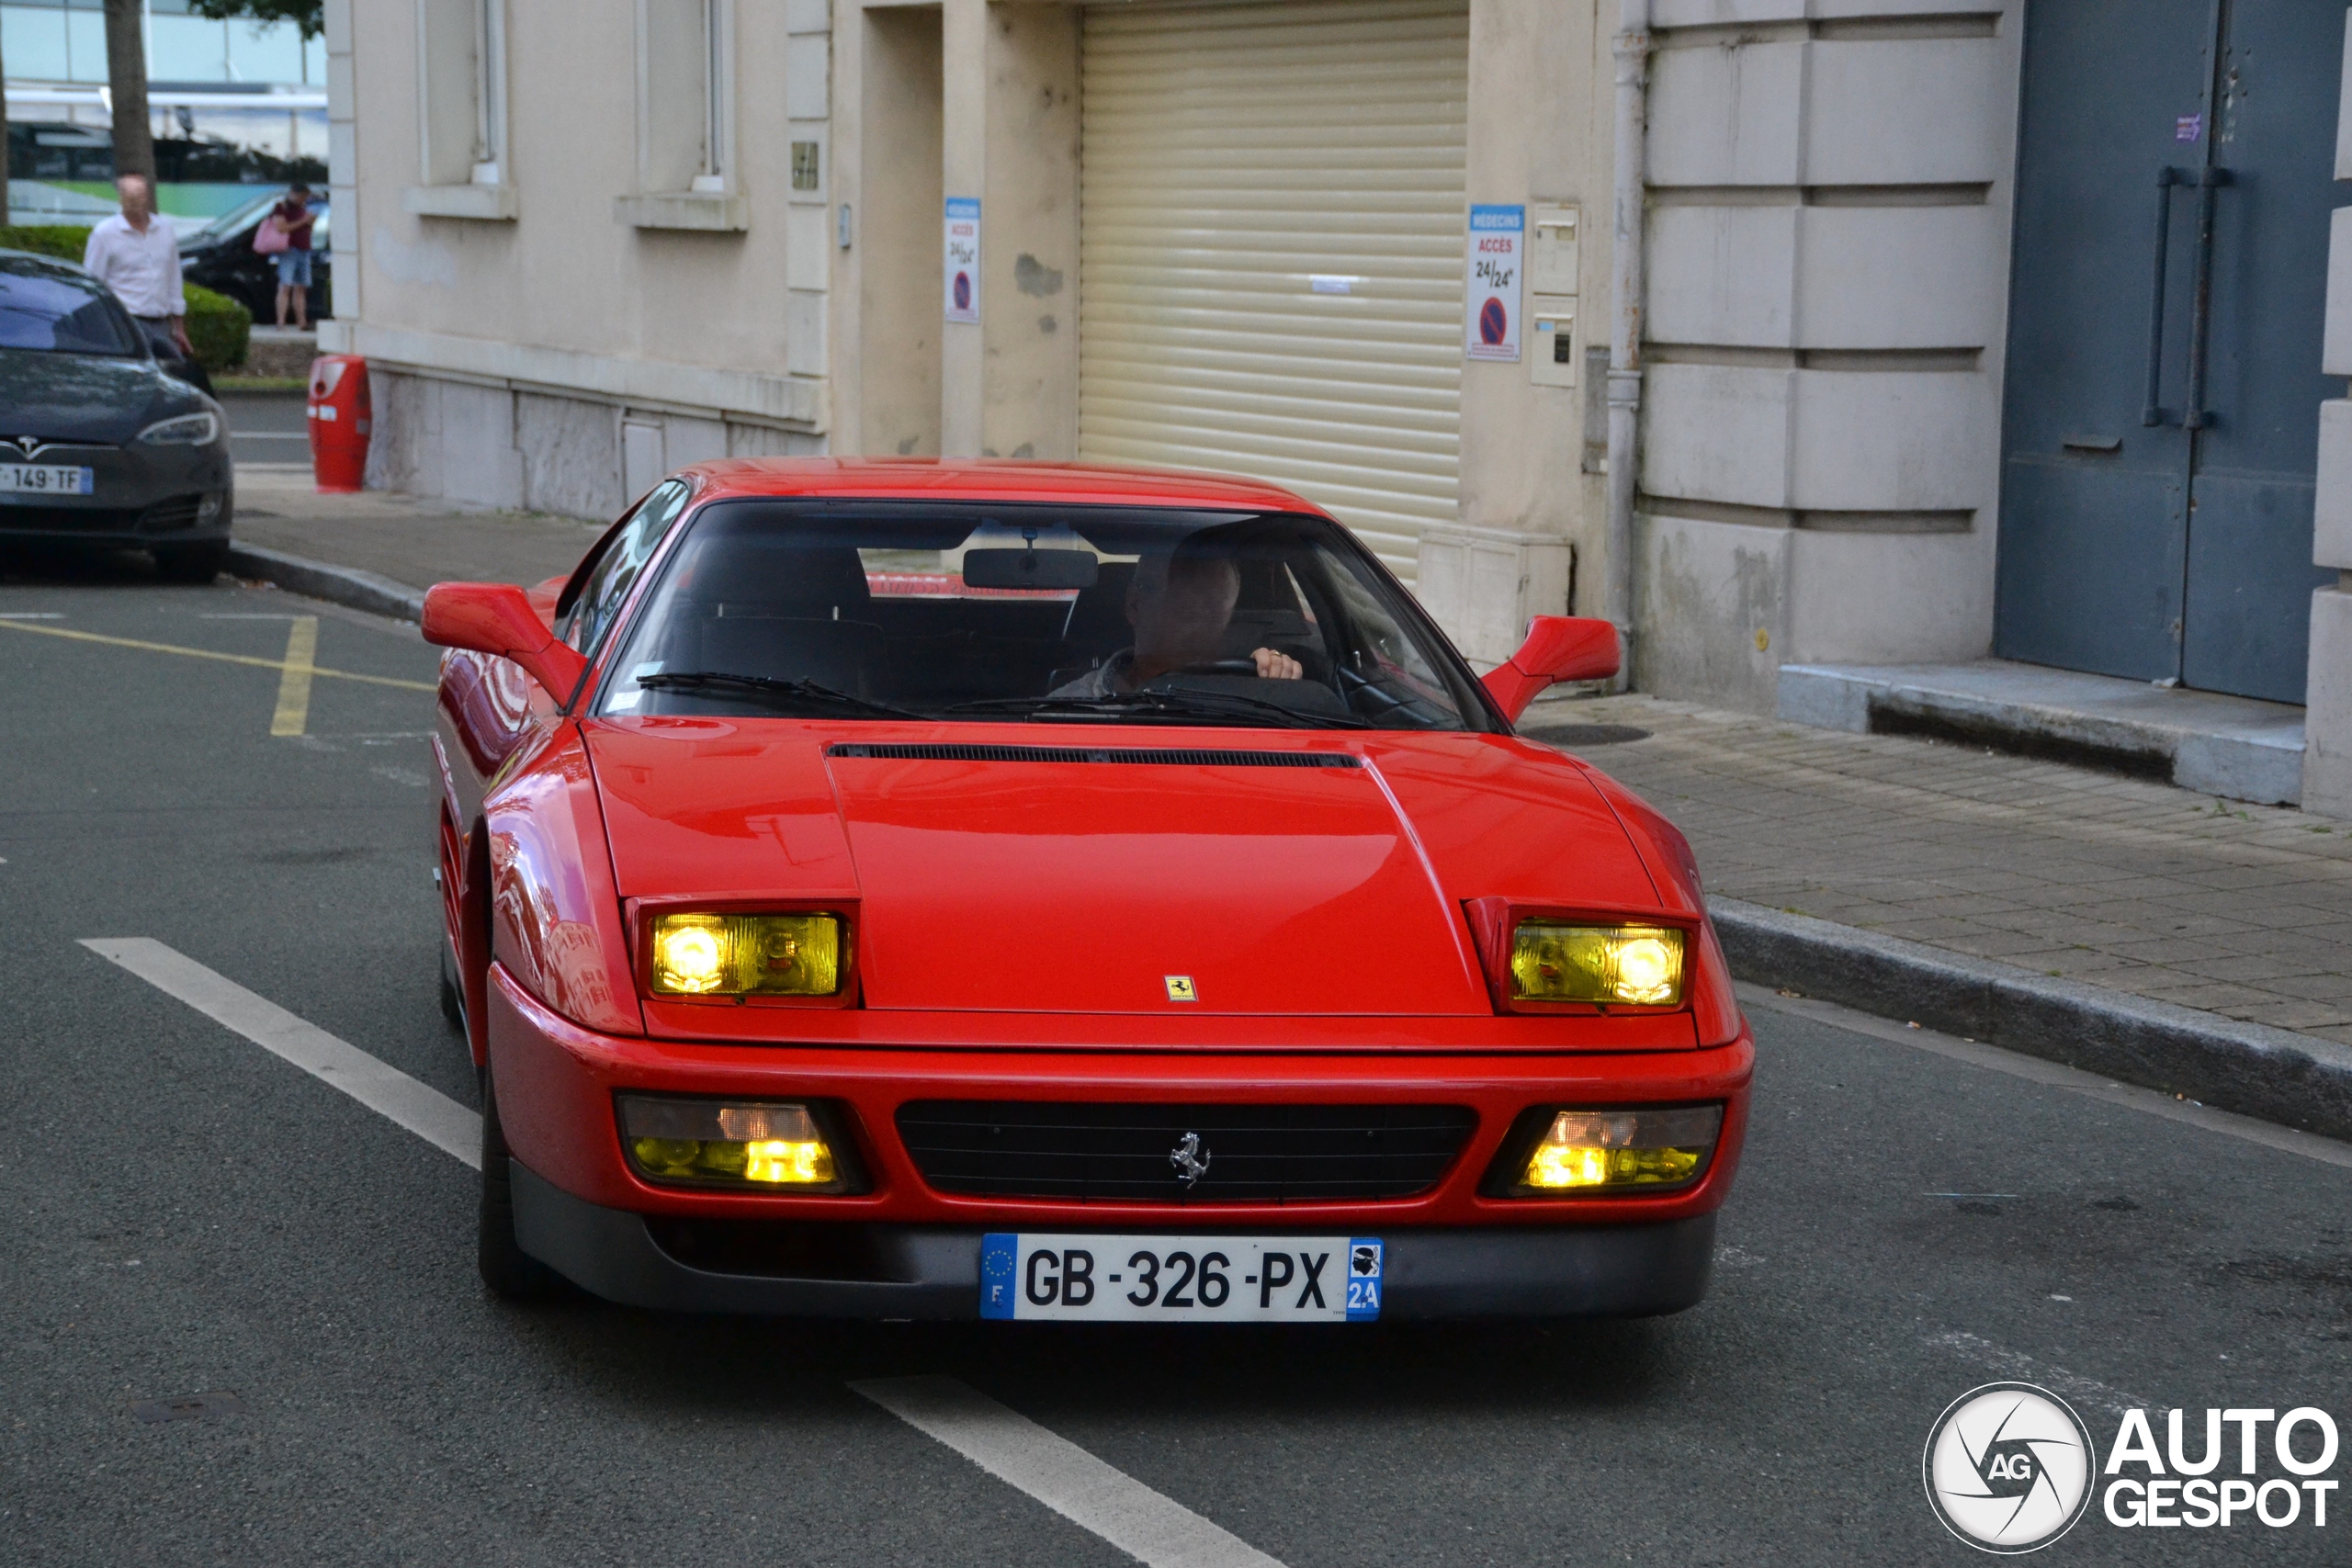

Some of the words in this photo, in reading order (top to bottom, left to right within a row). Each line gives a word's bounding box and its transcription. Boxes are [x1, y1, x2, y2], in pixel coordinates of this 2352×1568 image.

[1478, 235, 1512, 253] ACCÈS
[992, 1285, 1003, 1303] F
[1347, 1282, 1379, 1309] 2A
